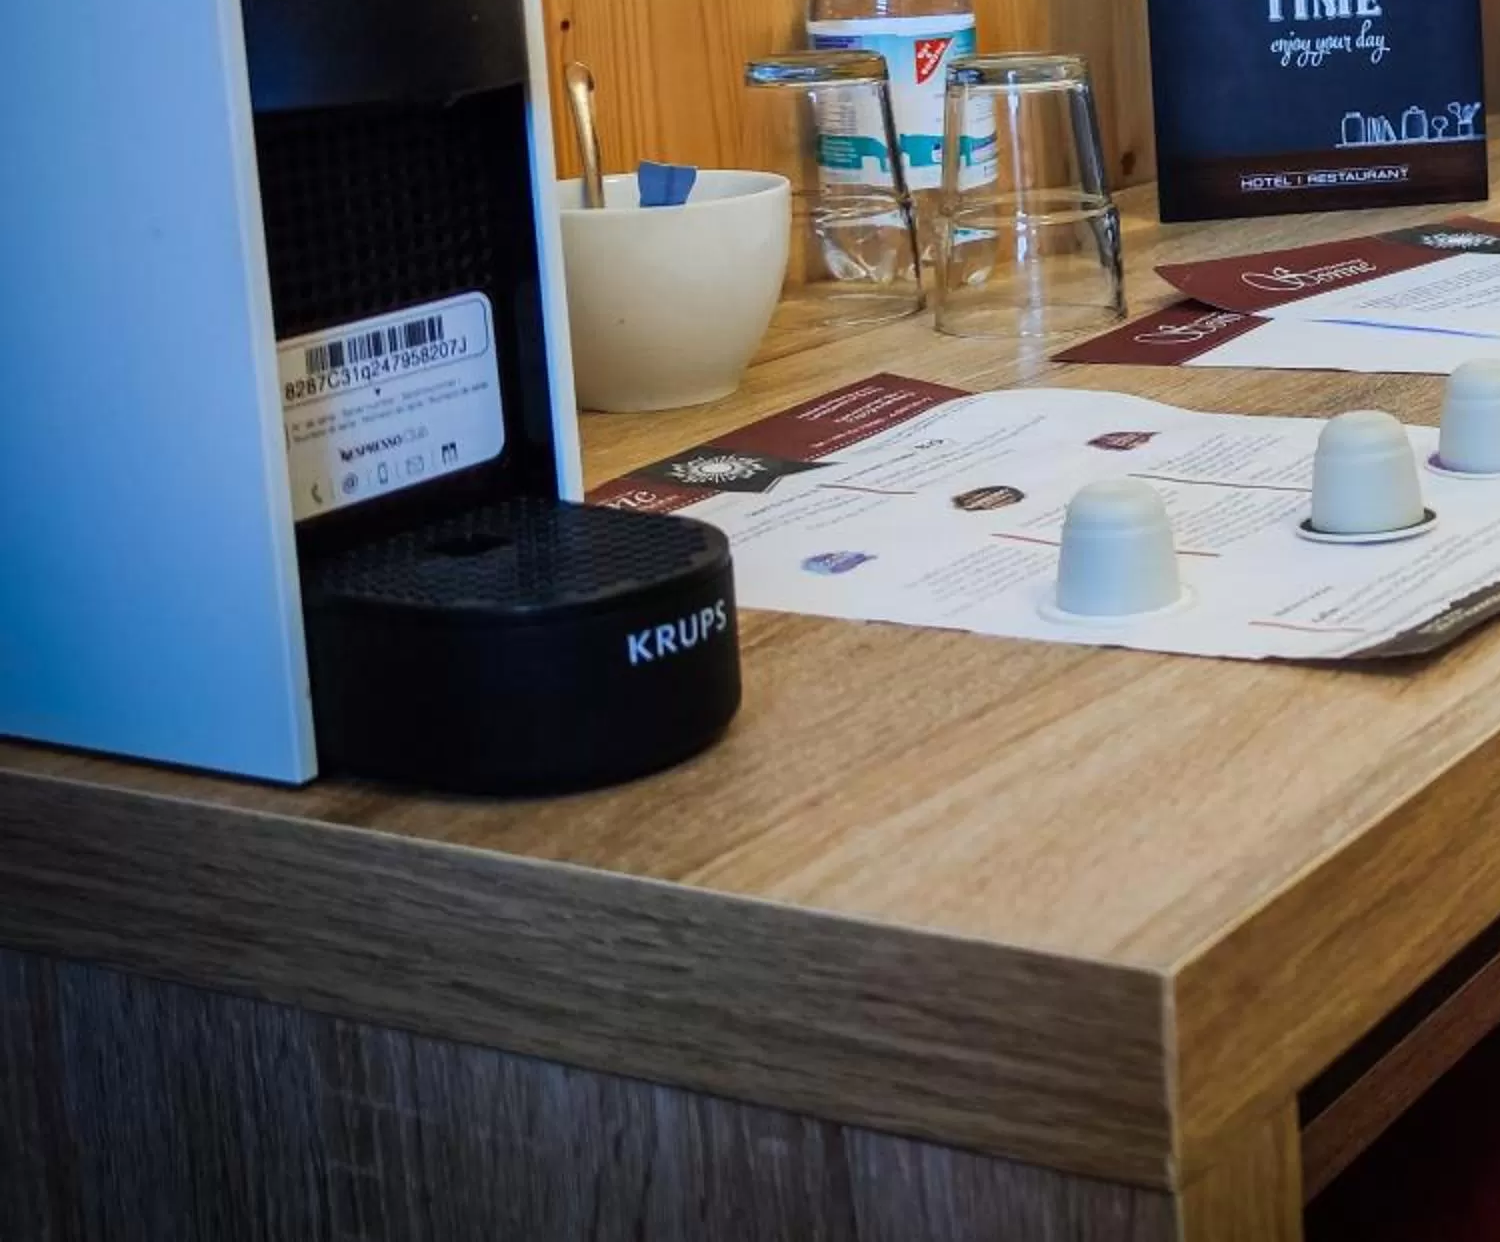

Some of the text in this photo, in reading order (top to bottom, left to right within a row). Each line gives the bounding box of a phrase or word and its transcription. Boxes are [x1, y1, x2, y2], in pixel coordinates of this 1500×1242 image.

[1270, 19, 1391, 67] enjoy your day
[1241, 175, 1292, 190] HOTEL
[1307, 166, 1409, 184] RESTAURANT
[627, 598, 727, 666] KRUPS
